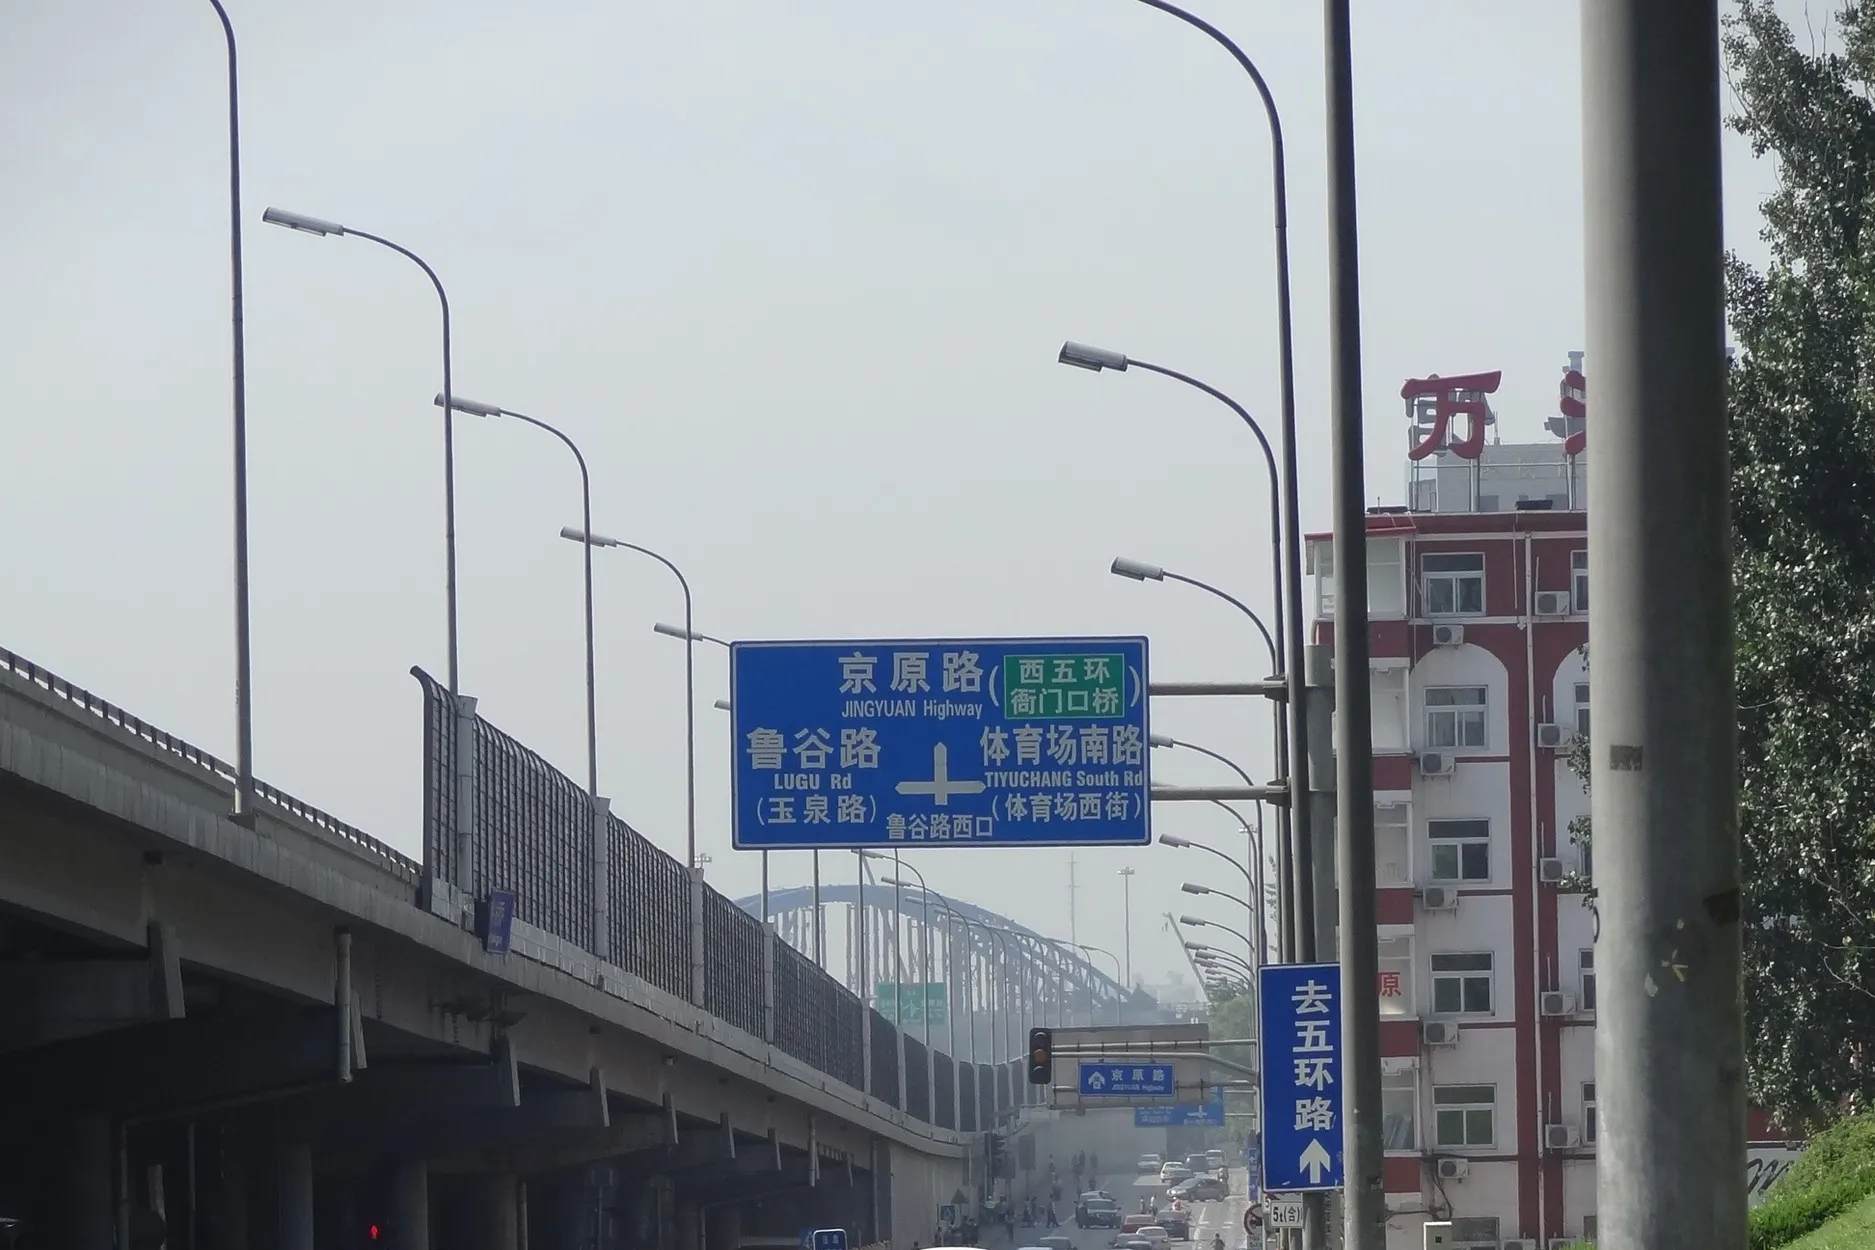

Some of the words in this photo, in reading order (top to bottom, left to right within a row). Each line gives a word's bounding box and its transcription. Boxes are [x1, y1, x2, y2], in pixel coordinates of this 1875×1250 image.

[838, 650, 984, 694] 京原路
[1019, 657, 1110, 684] 西五环
[841, 700, 916, 718] JINGYUAN
[923, 699, 983, 721] Highway
[1011, 687, 1119, 715] 衙门口桥
[746, 726, 881, 770] 鲁谷路
[980, 723, 1143, 766] 体育场南路
[774, 773, 820, 790] LUGU
[830, 772, 852, 789] Rd
[984, 770, 1072, 788] TIYUCHANG
[1076, 770, 1119, 787] South
[1124, 770, 1143, 787] Rd
[756, 794, 876, 826] (玉泉路)
[991, 790, 1141, 823] (体育场西街)
[886, 812, 993, 840] 鲁谷路西口
[1291, 979, 1334, 1132] 去五环路
[1111, 1068, 1165, 1082] 京原路
